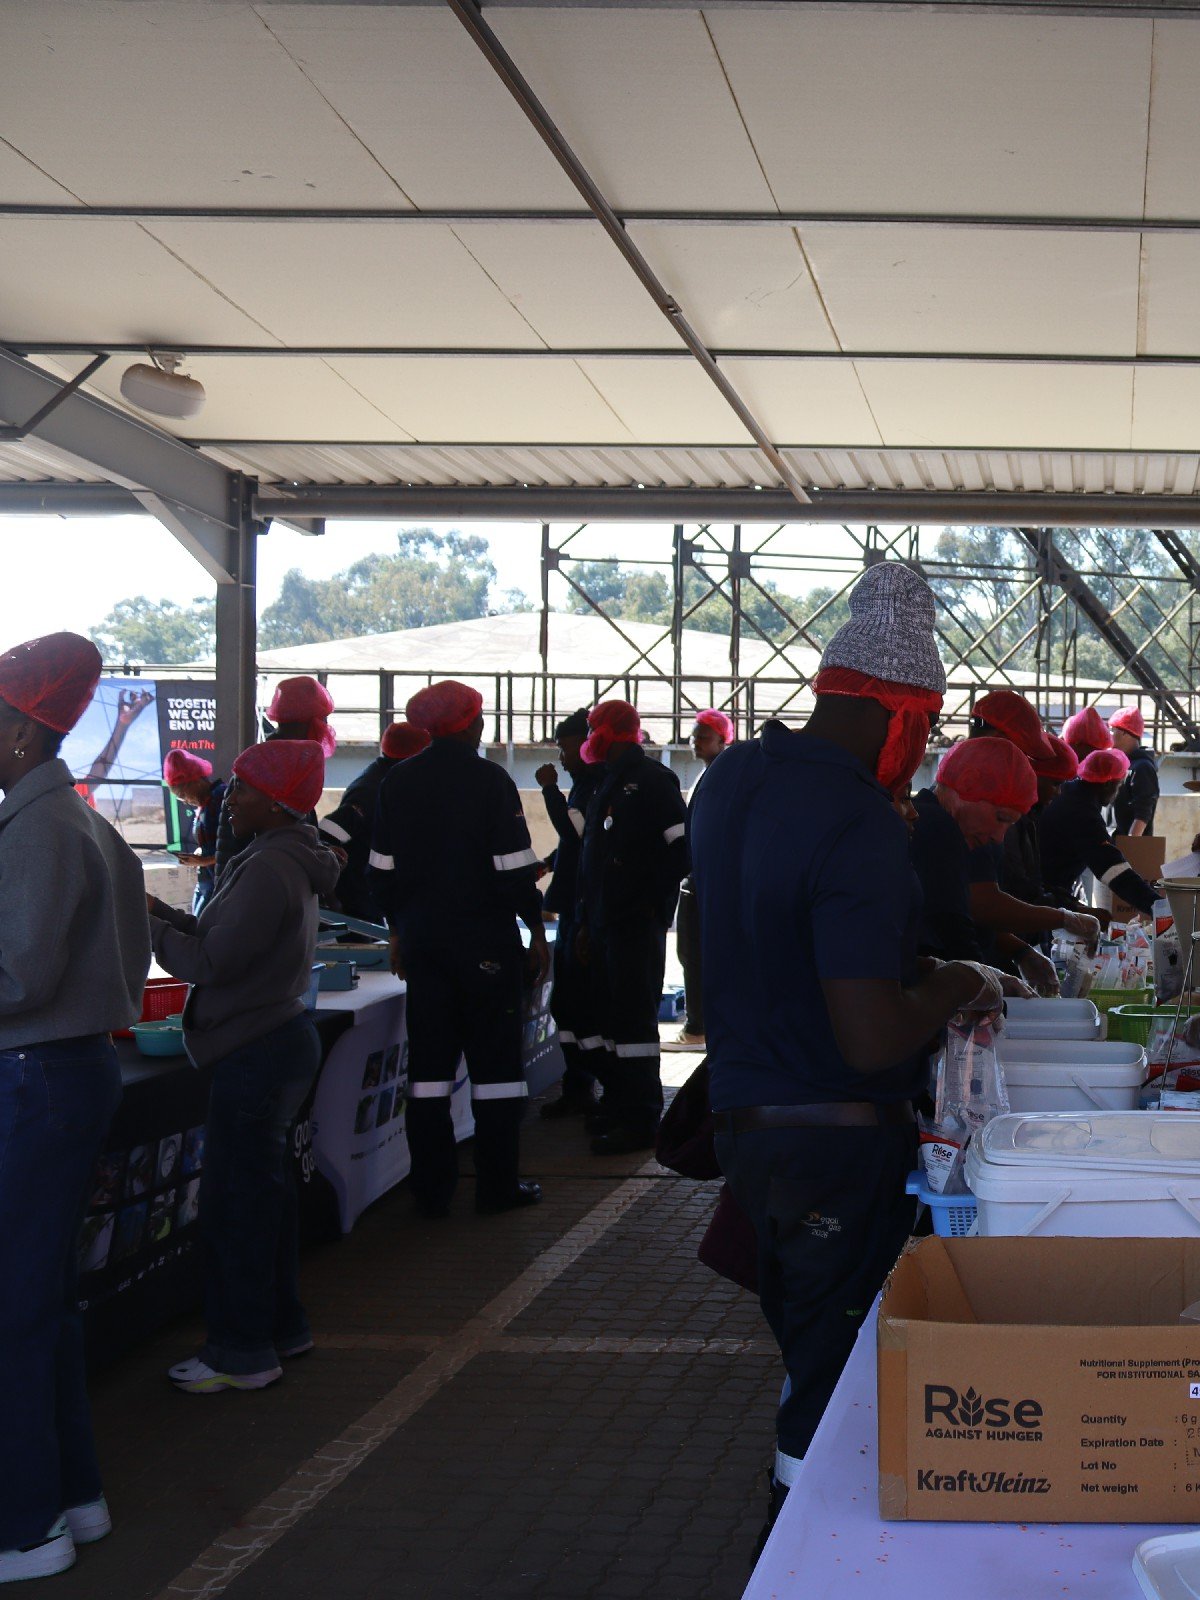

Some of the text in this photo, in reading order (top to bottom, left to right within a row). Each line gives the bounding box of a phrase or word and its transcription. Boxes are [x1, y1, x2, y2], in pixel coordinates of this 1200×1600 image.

[167, 698, 216, 709] TOGETH
[168, 709, 216, 720] WE CAN
[169, 720, 215, 731] END HU
[932, 1143, 953, 1159] Rise
[1079, 1359, 1126, 1368] Nutritional
[1127, 1358, 1180, 1368] Supplement
[1096, 1370, 1117, 1379] FOR
[1118, 1370, 1185, 1379] INSTITUTIONAL
[924, 1384, 1044, 1429] Rise
[1080, 1414, 1128, 1426] Quantity
[1181, 1413, 1188, 1423] 6
[1190, 1415, 1198, 1425] g
[925, 1427, 1044, 1442] AGAINST HUNGER
[1080, 1438, 1137, 1450] Expiration
[1139, 1438, 1165, 1448] Date
[1080, 1461, 1100, 1470] Lot
[1101, 1462, 1117, 1470] No
[1080, 1484, 1100, 1493] Net
[1102, 1484, 1139, 1494] weight
[1185, 1483, 1193, 1492] 6
